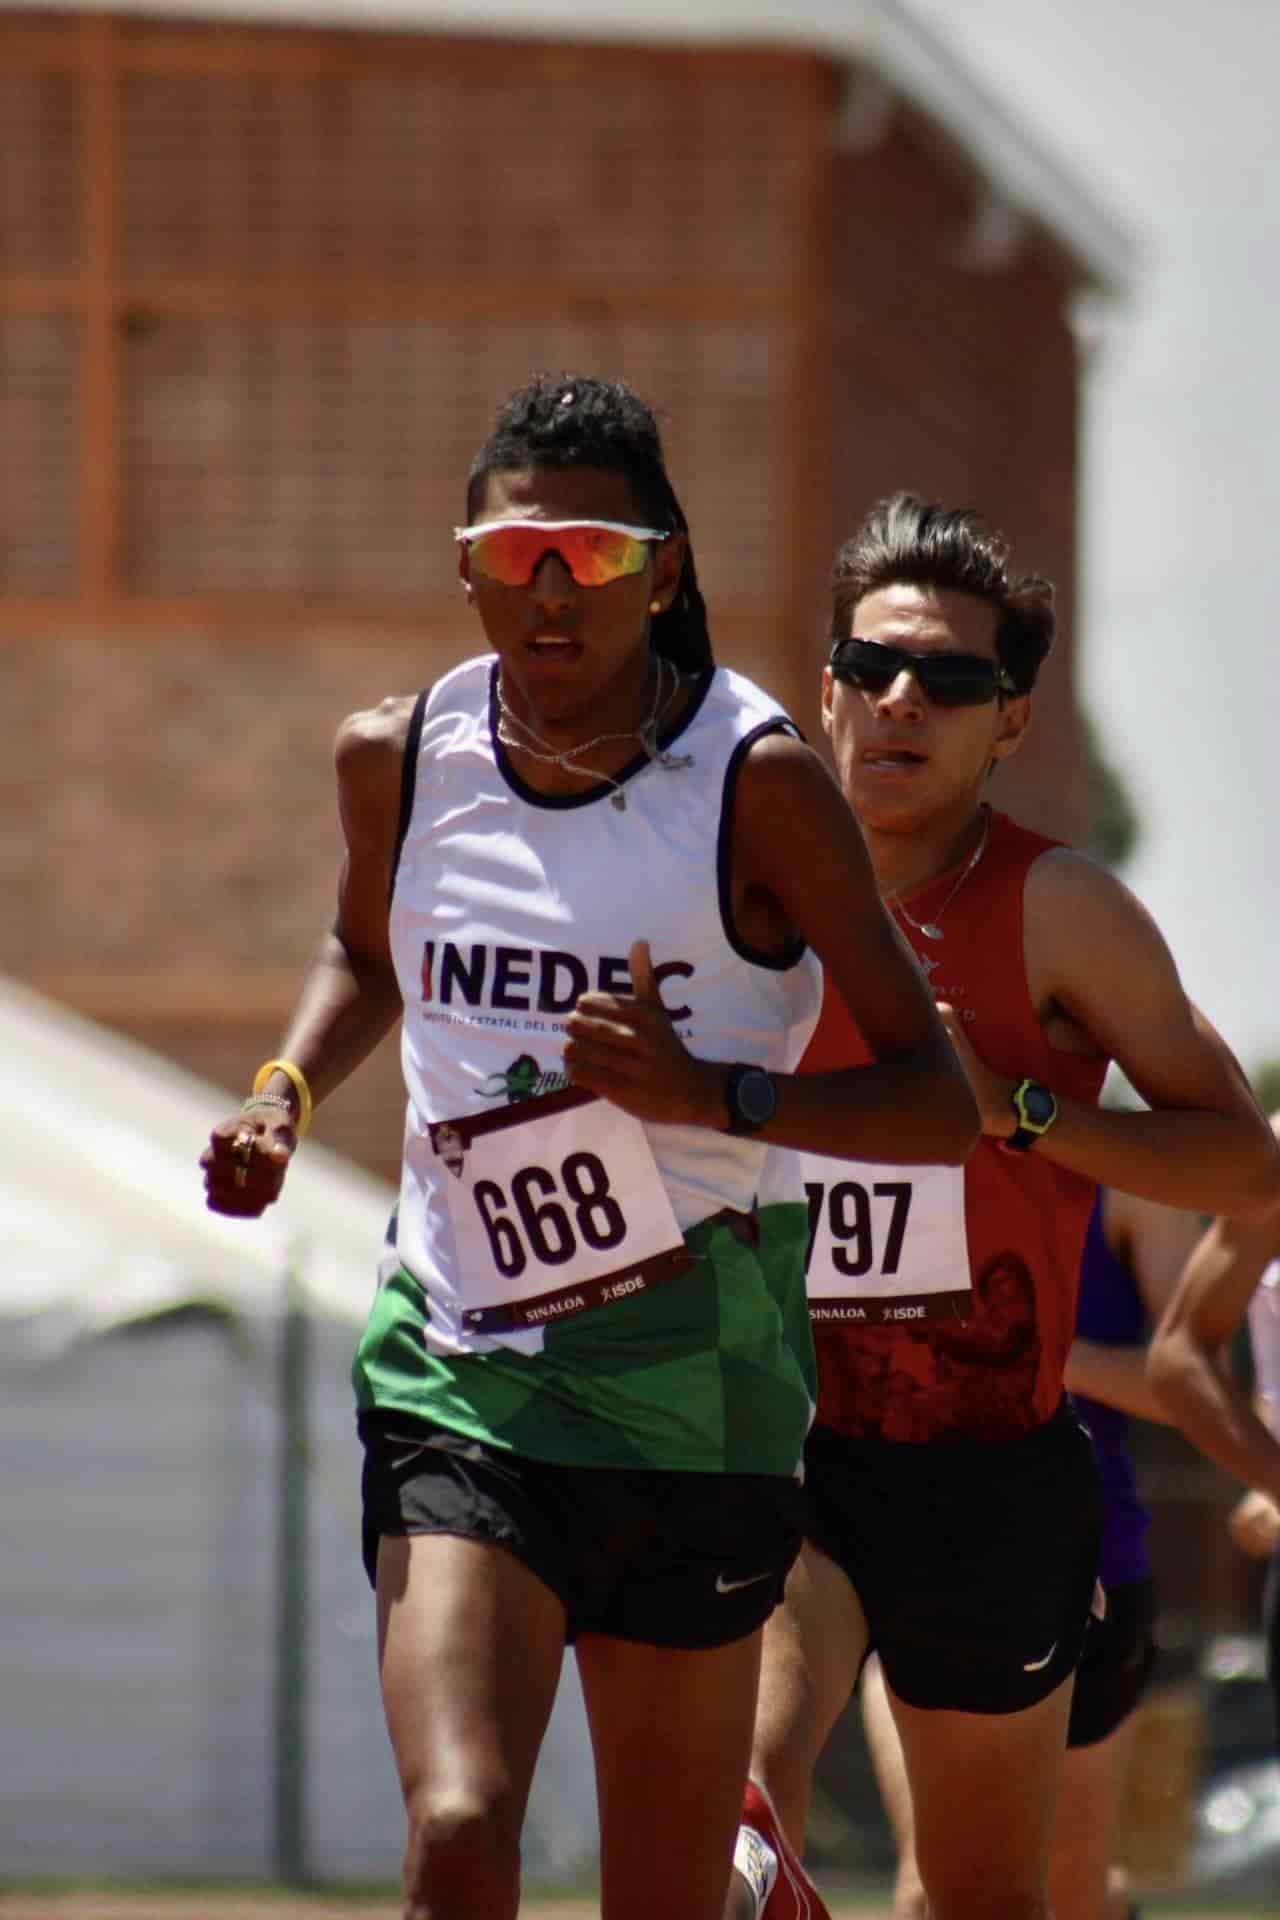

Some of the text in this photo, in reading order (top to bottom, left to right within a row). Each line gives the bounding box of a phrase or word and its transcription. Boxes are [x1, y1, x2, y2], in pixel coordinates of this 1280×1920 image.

[421, 940, 694, 1021] INEDEC
[473, 1151, 627, 1279] 668
[804, 1181, 912, 1277] 797
[526, 1296, 585, 1322] SINALOA
[808, 1307, 866, 1320] SINALOA
